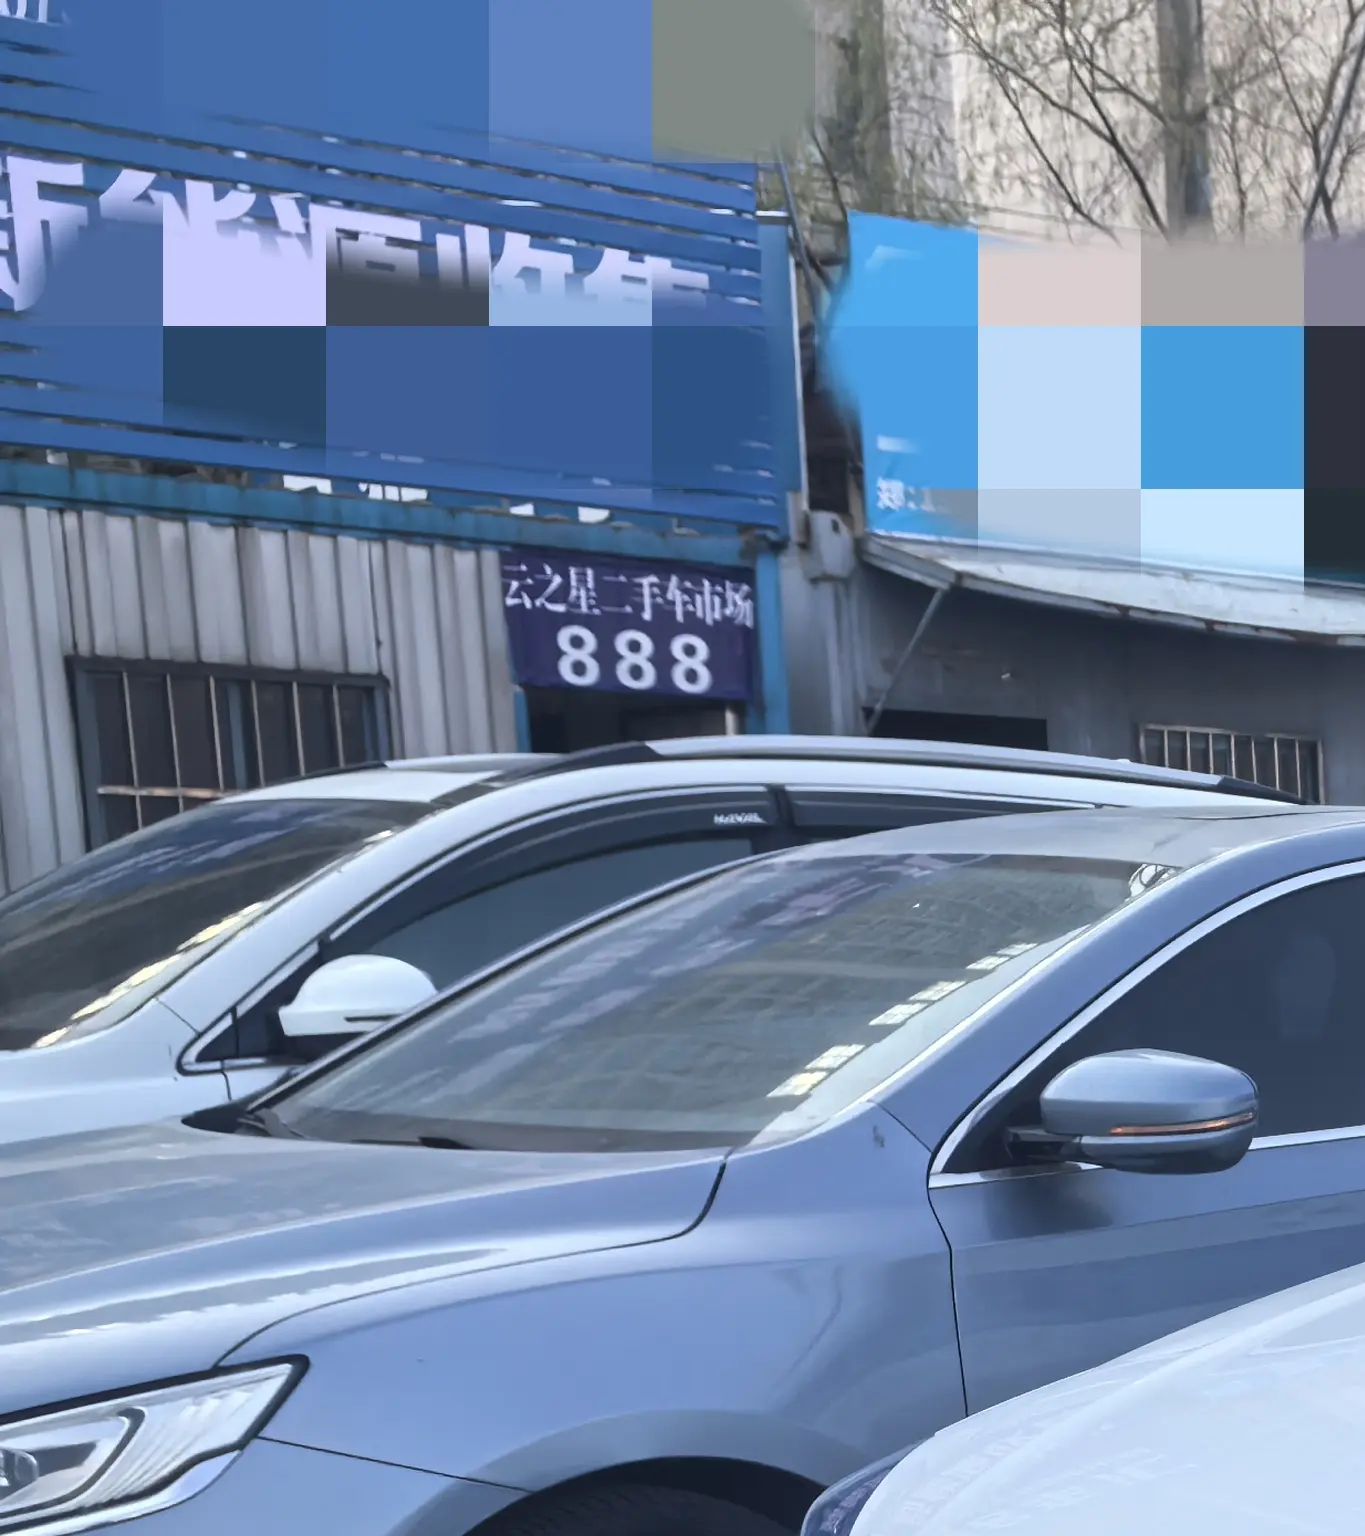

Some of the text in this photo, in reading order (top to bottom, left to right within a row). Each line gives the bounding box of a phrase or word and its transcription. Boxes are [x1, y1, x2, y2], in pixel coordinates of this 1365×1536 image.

[501, 562, 754, 630] 云之星二手车市场
[556, 624, 714, 695] 888
